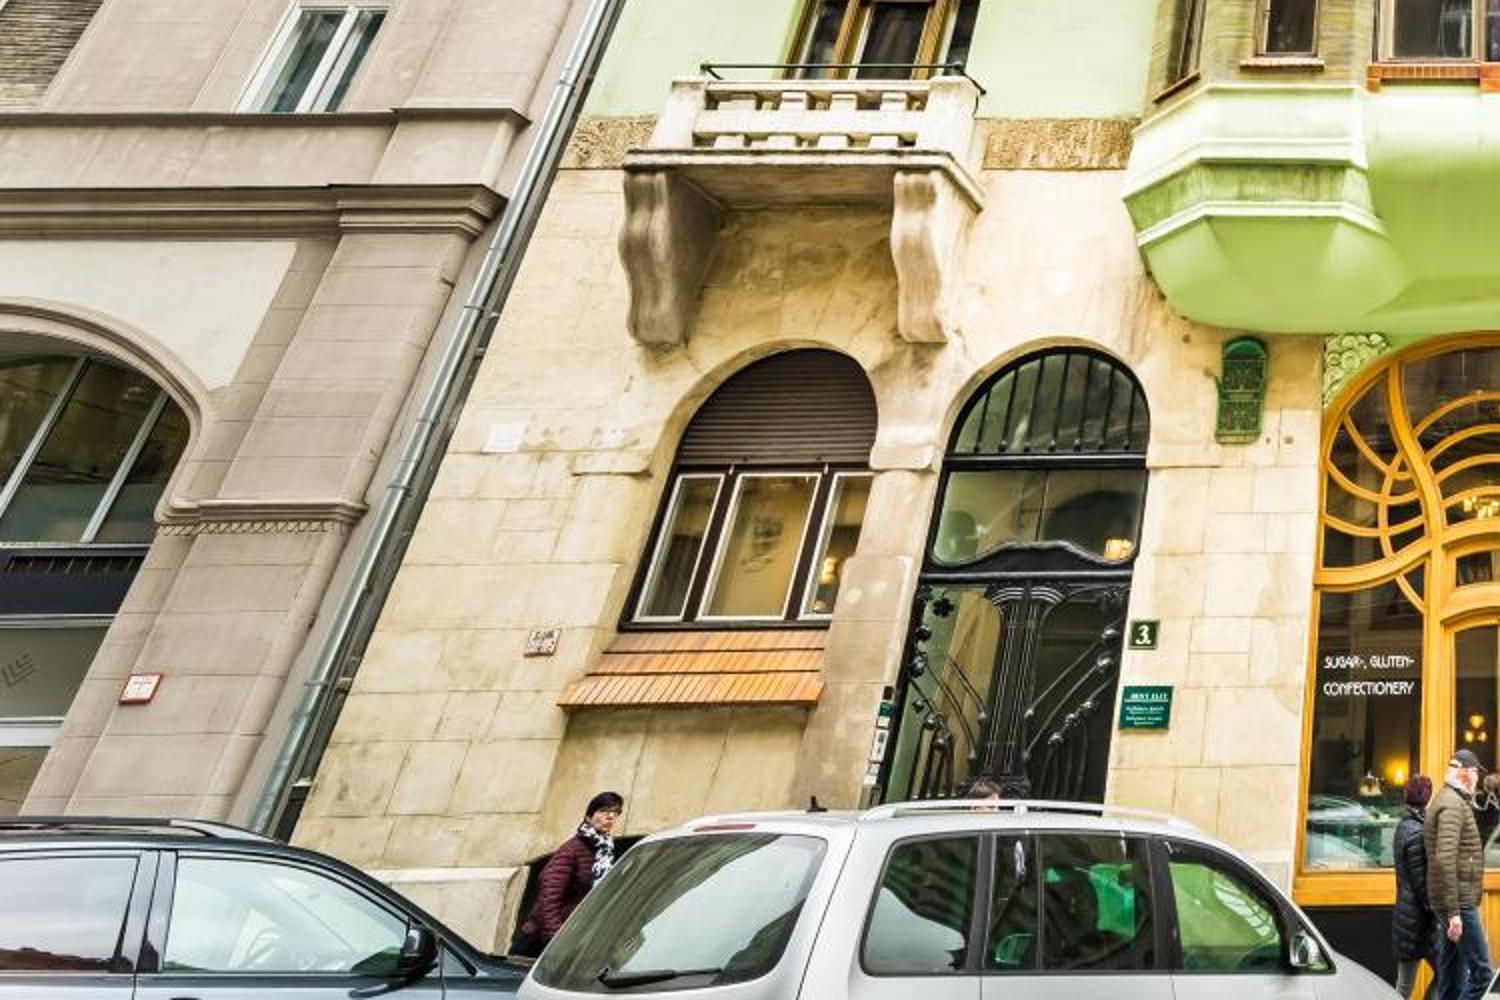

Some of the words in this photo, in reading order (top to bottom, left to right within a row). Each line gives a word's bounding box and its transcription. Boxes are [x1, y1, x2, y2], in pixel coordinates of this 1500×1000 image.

[1135, 624, 1152, 645] 3.
[1369, 654, 1415, 669] GLUTEN-
[1323, 681, 1415, 696] CONFECTIONERY
